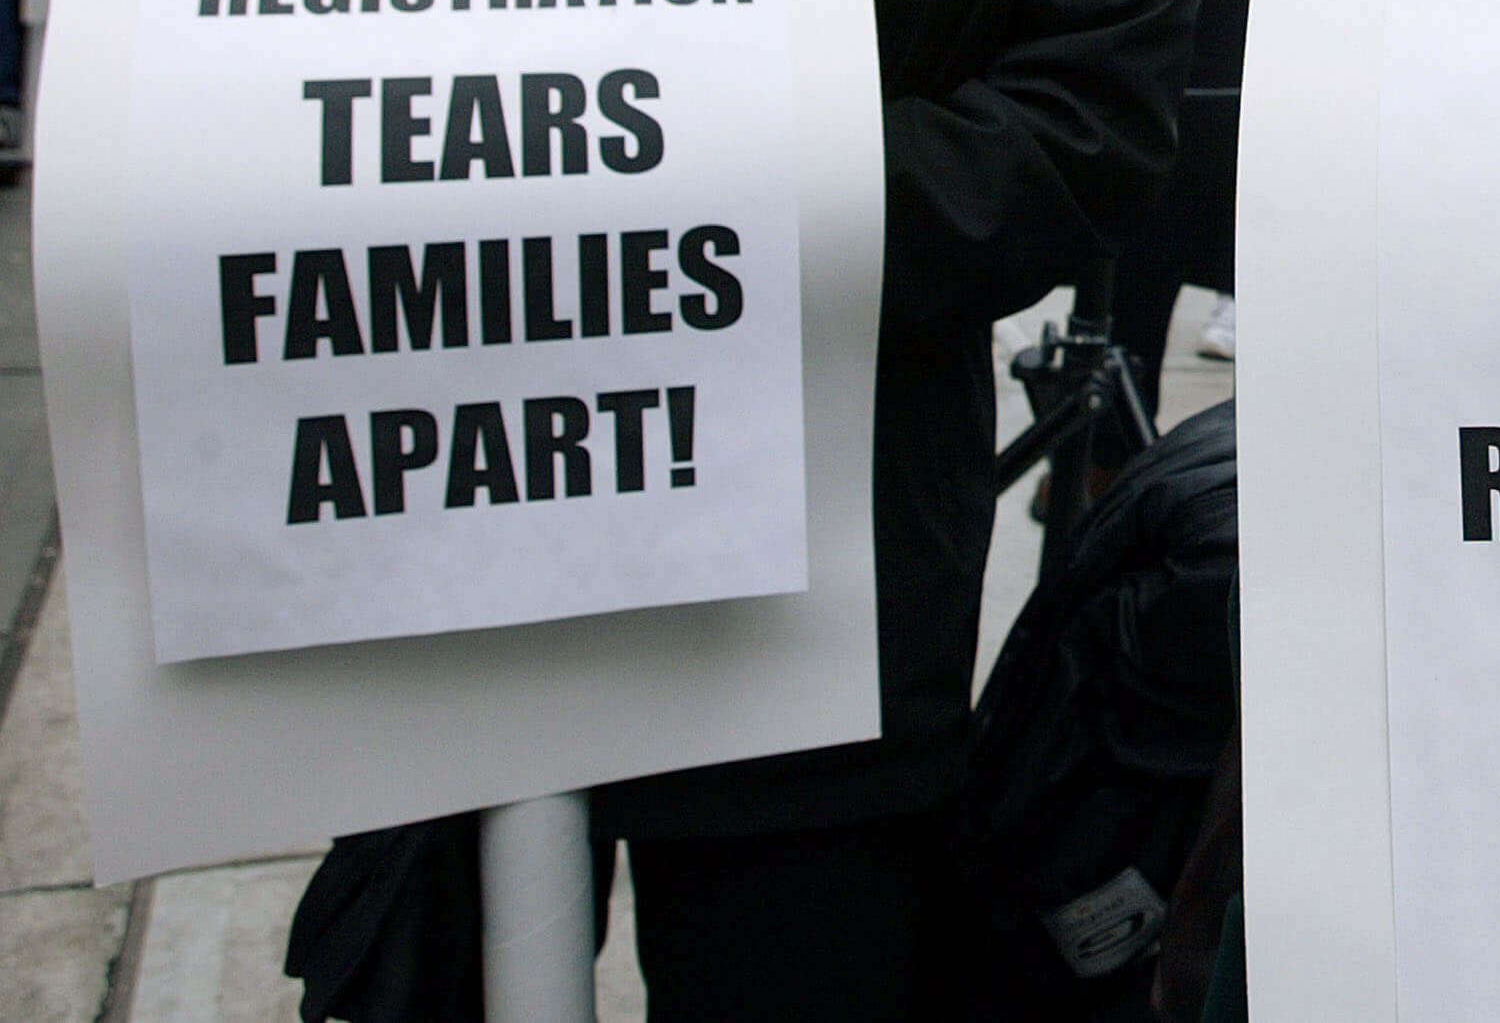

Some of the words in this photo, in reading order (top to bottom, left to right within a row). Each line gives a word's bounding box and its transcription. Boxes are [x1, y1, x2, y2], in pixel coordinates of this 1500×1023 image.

[302, 67, 666, 188] TEARS
[217, 223, 745, 368] FAMILIES
[284, 383, 697, 527] APART!
